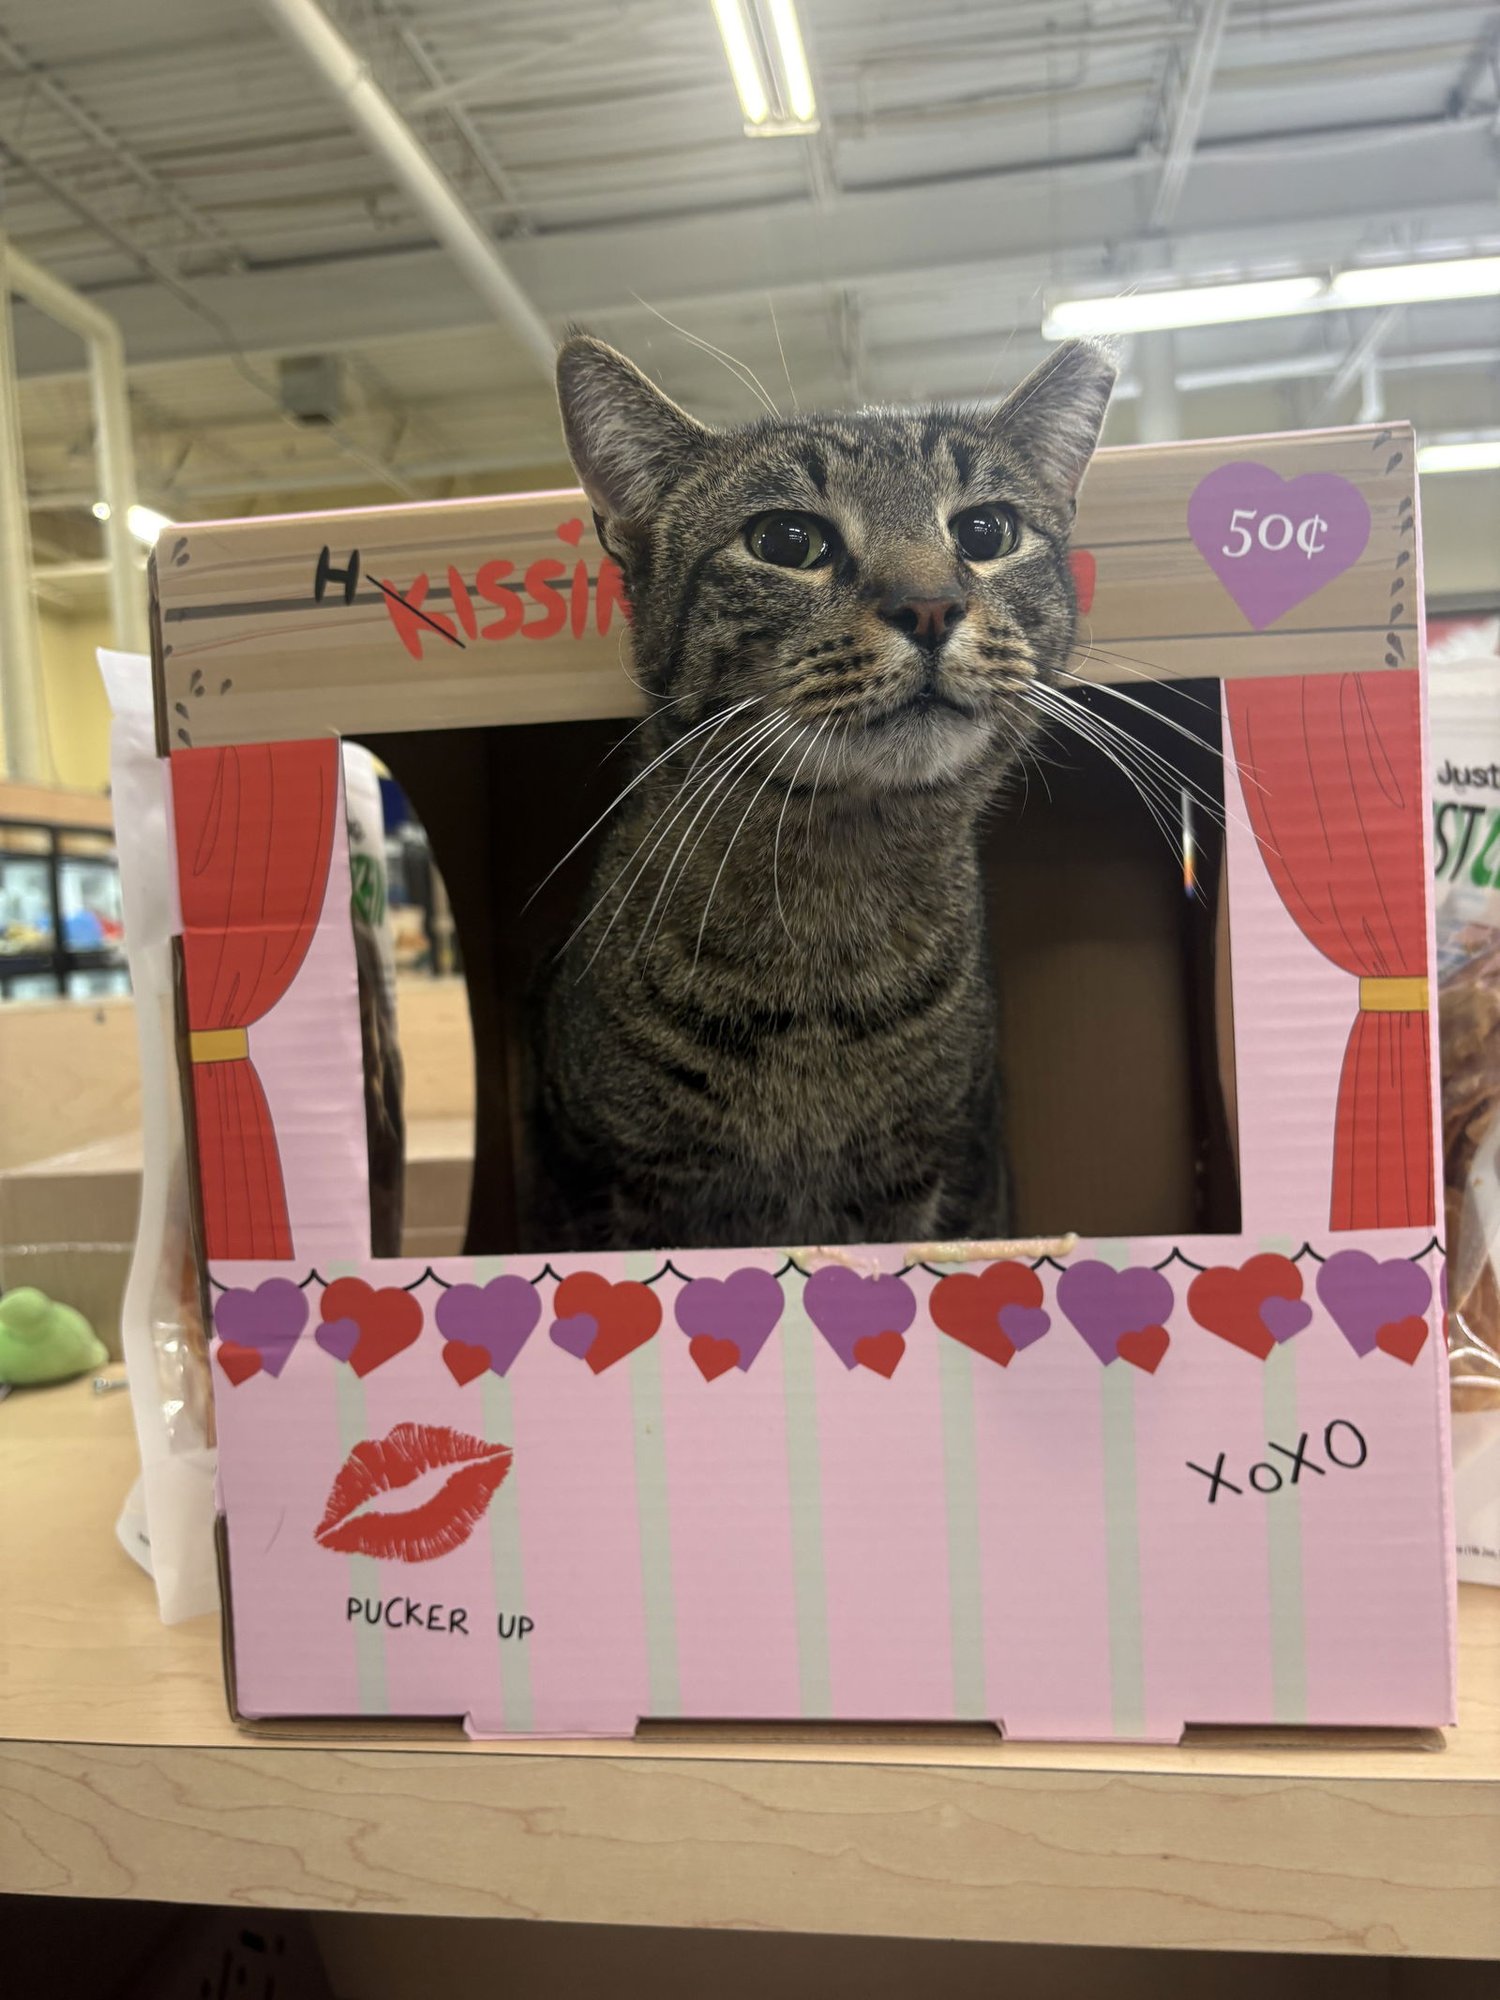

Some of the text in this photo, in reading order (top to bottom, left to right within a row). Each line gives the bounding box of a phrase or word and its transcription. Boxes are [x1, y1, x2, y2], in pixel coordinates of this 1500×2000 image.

[1221, 508, 1329, 560] 50¢
[346, 1596, 535, 1640] PUCKER UP
